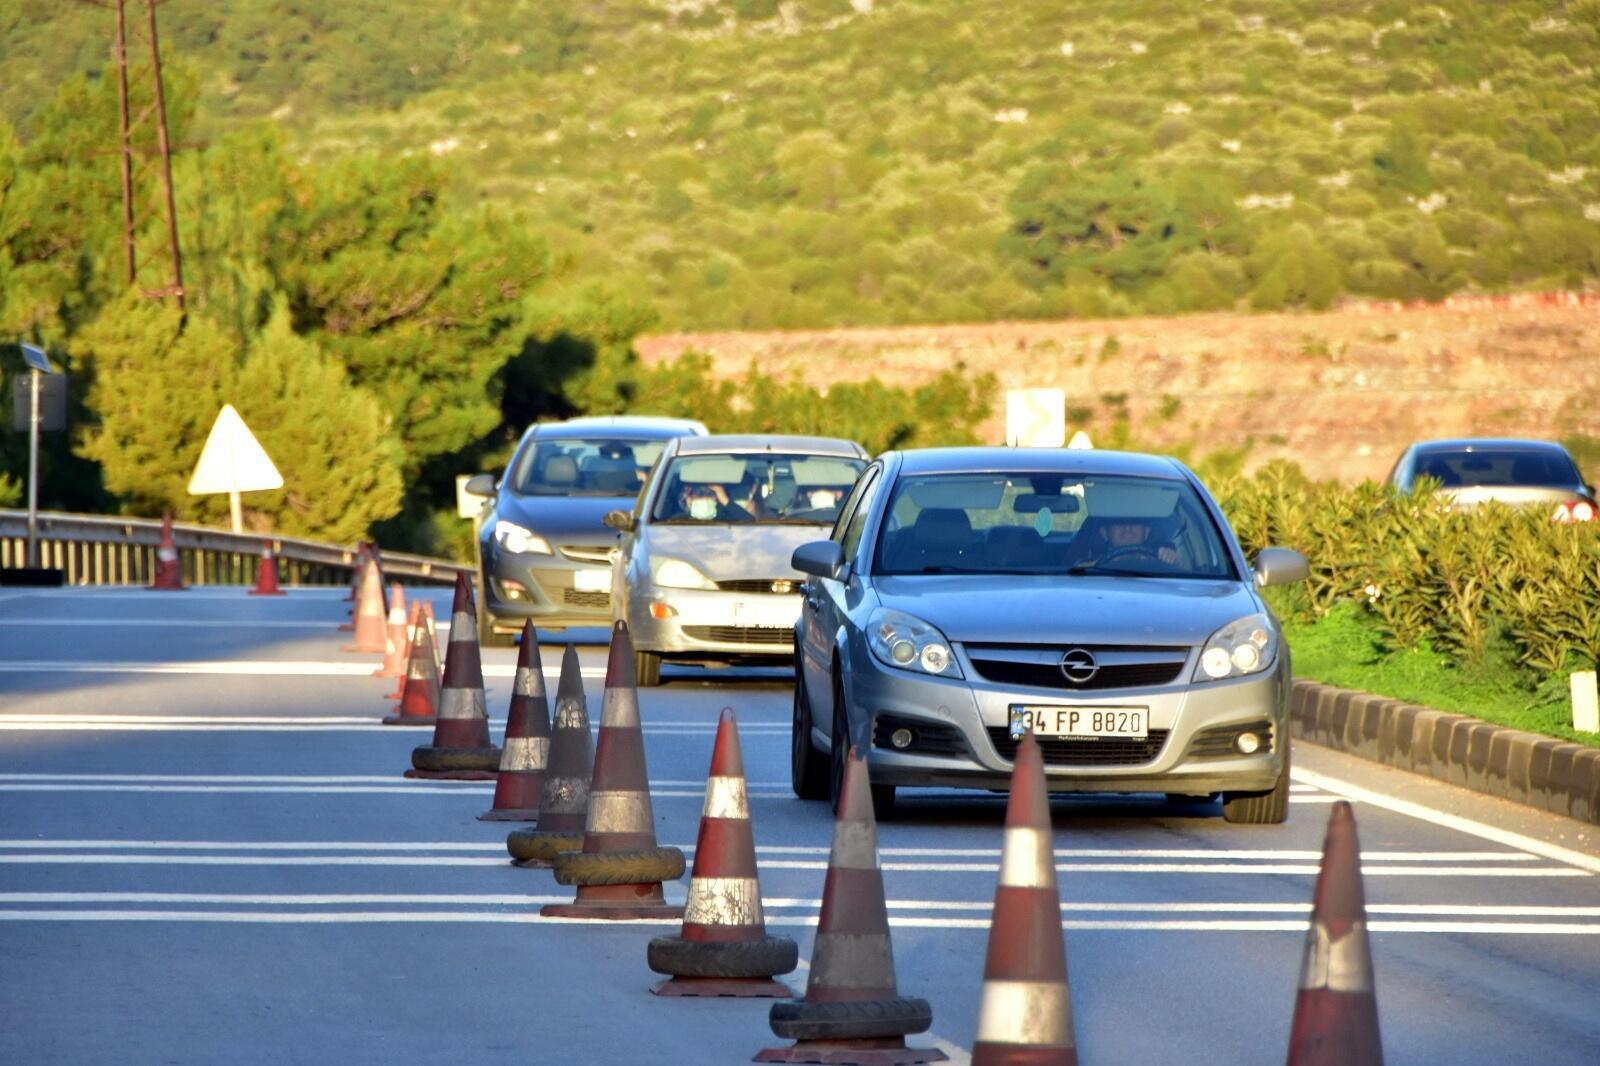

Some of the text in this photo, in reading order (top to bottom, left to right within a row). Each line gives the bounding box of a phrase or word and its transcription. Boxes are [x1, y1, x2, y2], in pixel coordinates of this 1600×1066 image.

[1024, 710, 1141, 732] 34 FP 8820
